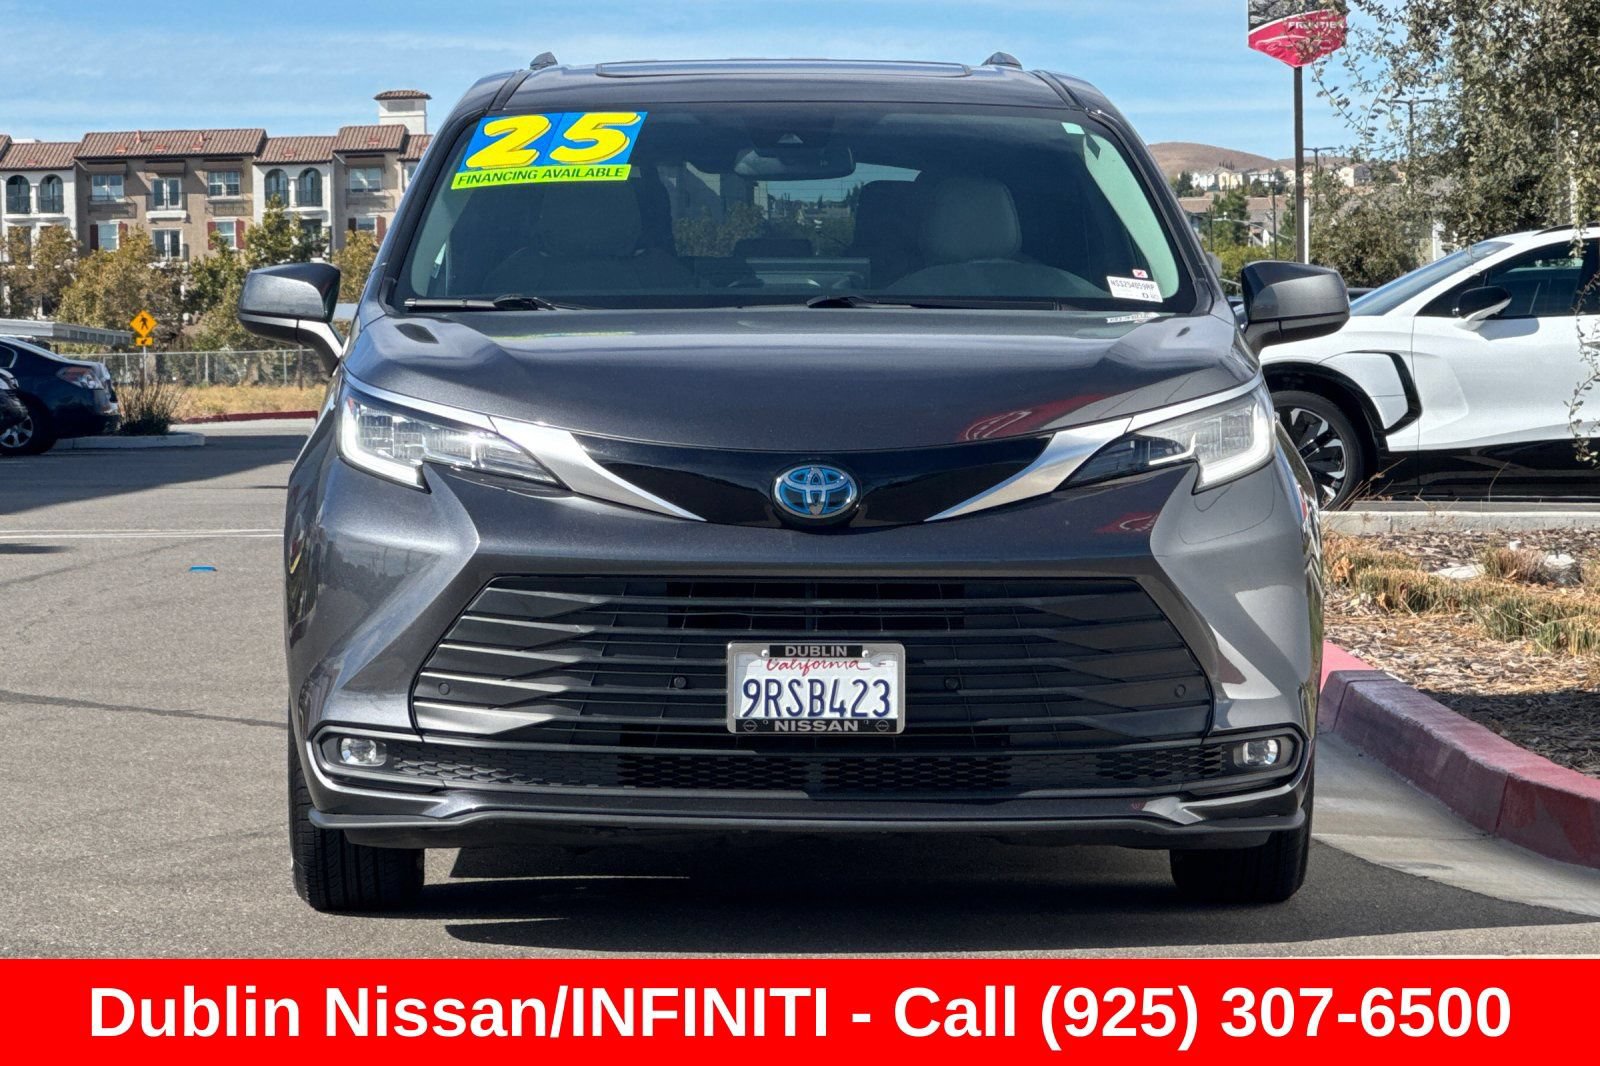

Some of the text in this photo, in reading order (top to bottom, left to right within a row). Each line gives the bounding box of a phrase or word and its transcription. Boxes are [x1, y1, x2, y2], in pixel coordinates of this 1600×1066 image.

[1288, 21, 1344, 29] FRNTIE
[466, 112, 641, 170] 25
[457, 167, 625, 186] FINANCING AVAILABLE
[784, 646, 847, 657] DUBLIN
[766, 658, 870, 677] California
[742, 678, 890, 718] 9RSB423
[774, 720, 858, 732] NISSAN
